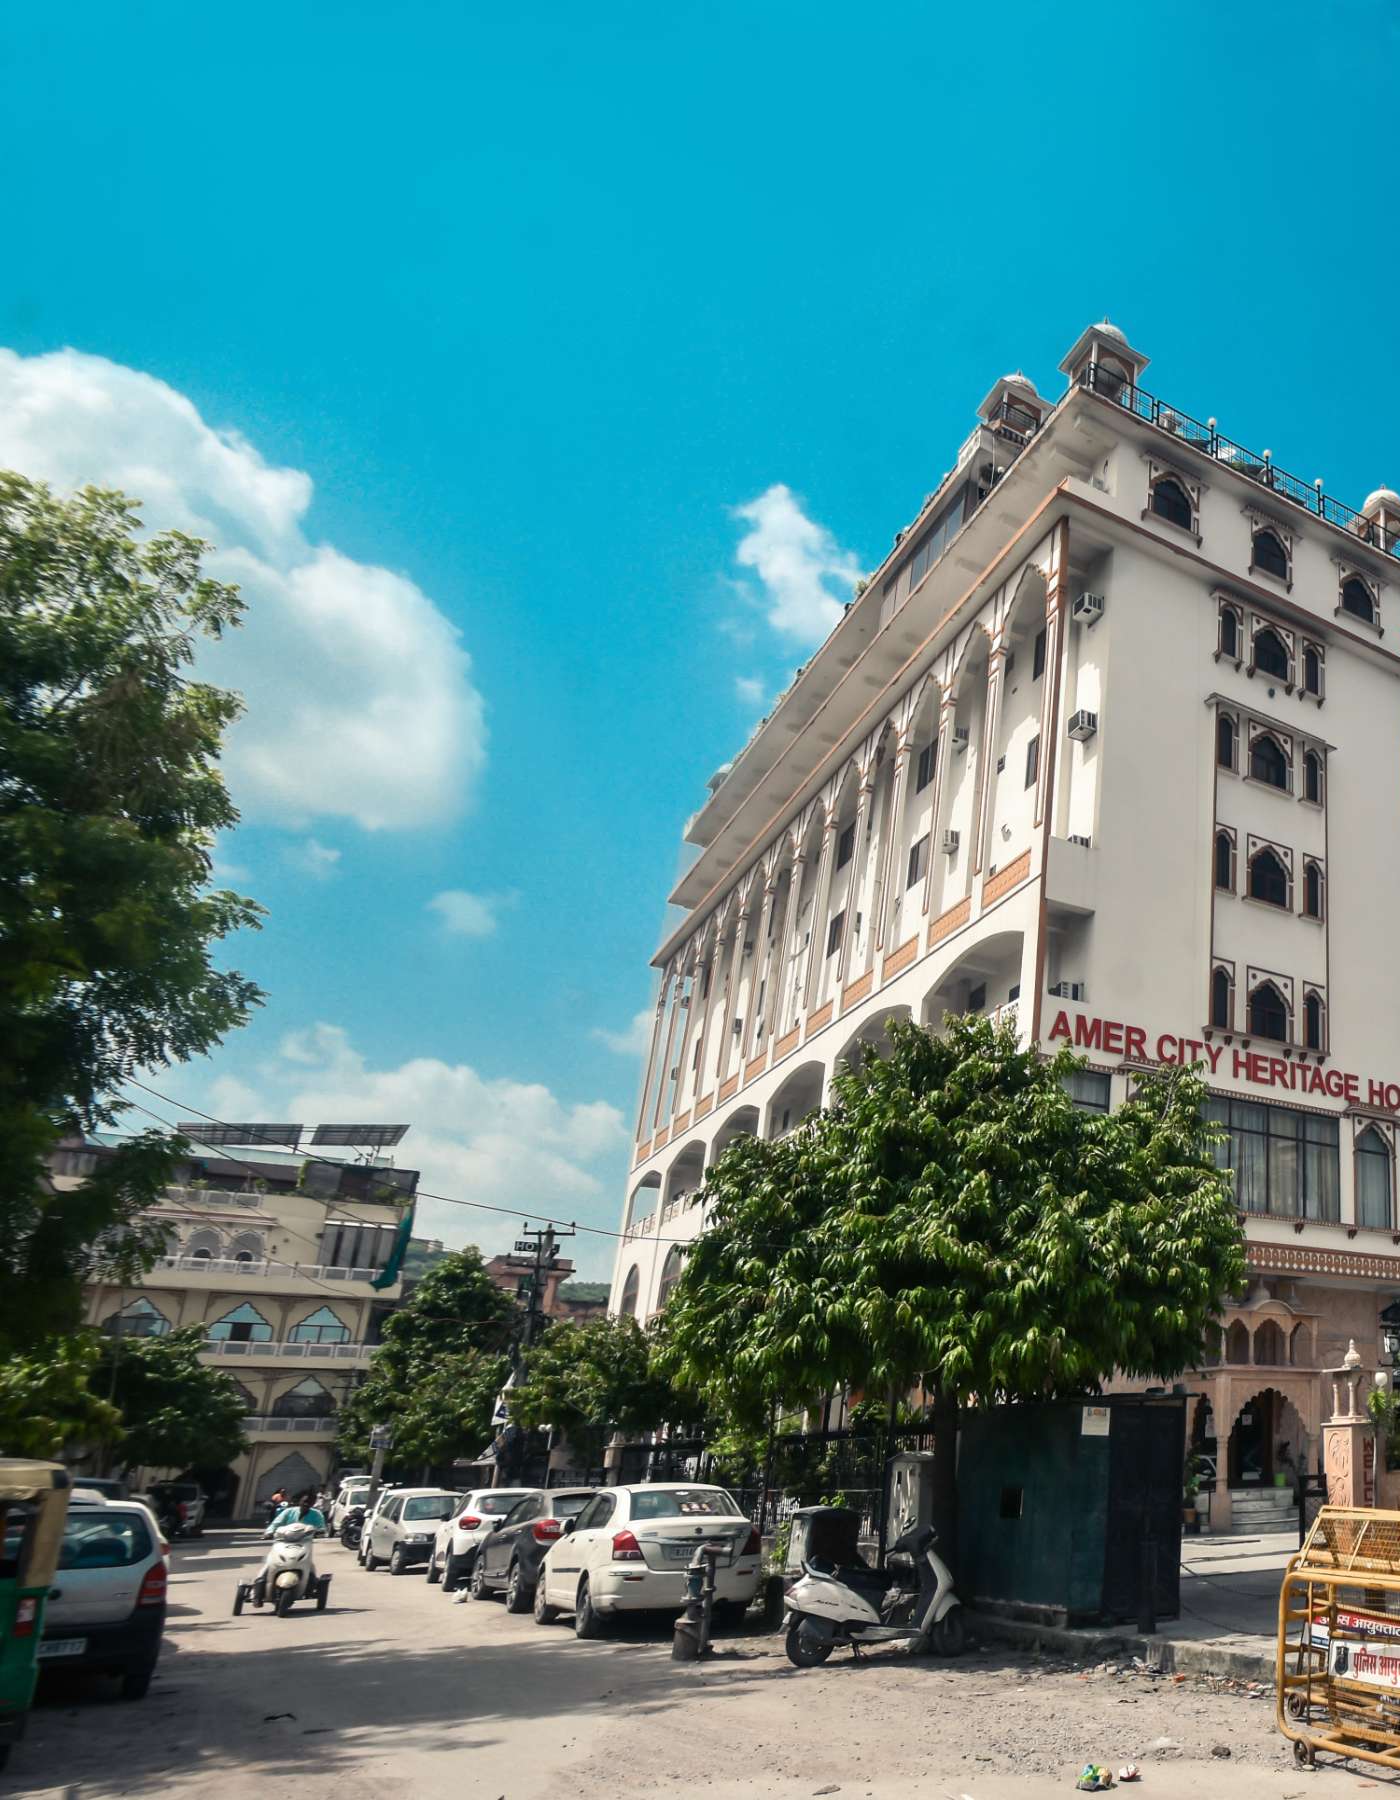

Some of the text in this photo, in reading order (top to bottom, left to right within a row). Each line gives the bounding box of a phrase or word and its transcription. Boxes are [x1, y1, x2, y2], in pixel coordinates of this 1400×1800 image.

[1048, 1010, 1150, 1060] AMER
[1156, 1034, 1224, 1074] CITY
[1231, 1049, 1361, 1104] HERITAGE
[1352, 1647, 1378, 1679] पुलिस
